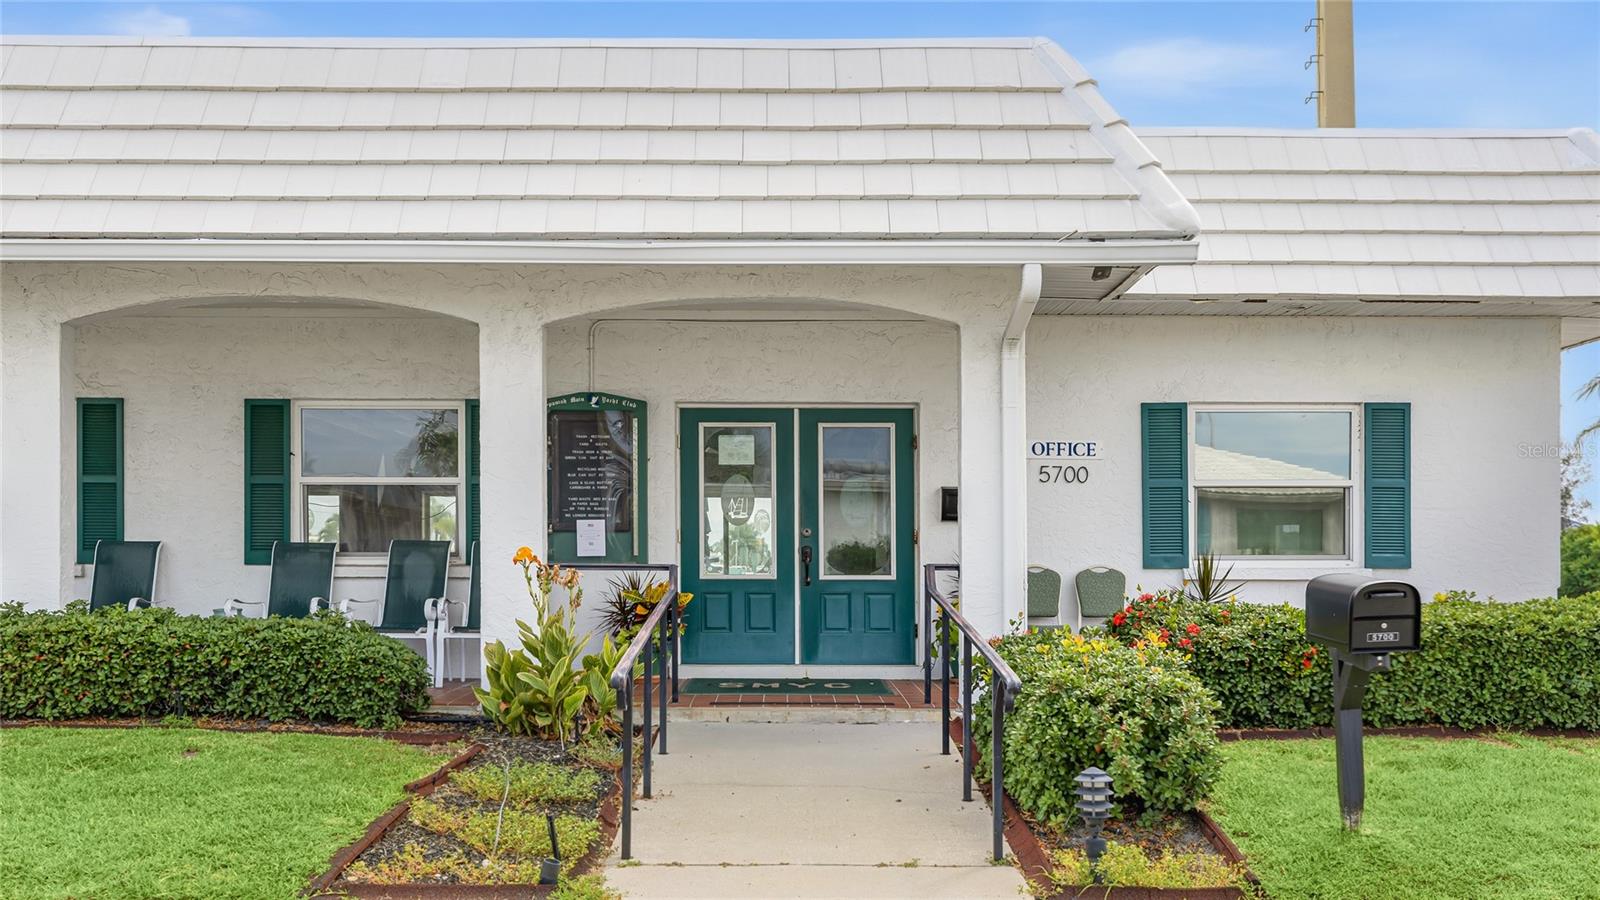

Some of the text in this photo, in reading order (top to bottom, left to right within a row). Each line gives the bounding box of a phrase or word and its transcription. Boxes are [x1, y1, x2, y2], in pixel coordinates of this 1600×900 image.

[601, 396, 619, 405] Yacht
[622, 399, 637, 408] Club
[1031, 441, 1097, 457] OFFICE
[1039, 465, 1089, 484] 5700
[1372, 633, 1394, 641] 5700
